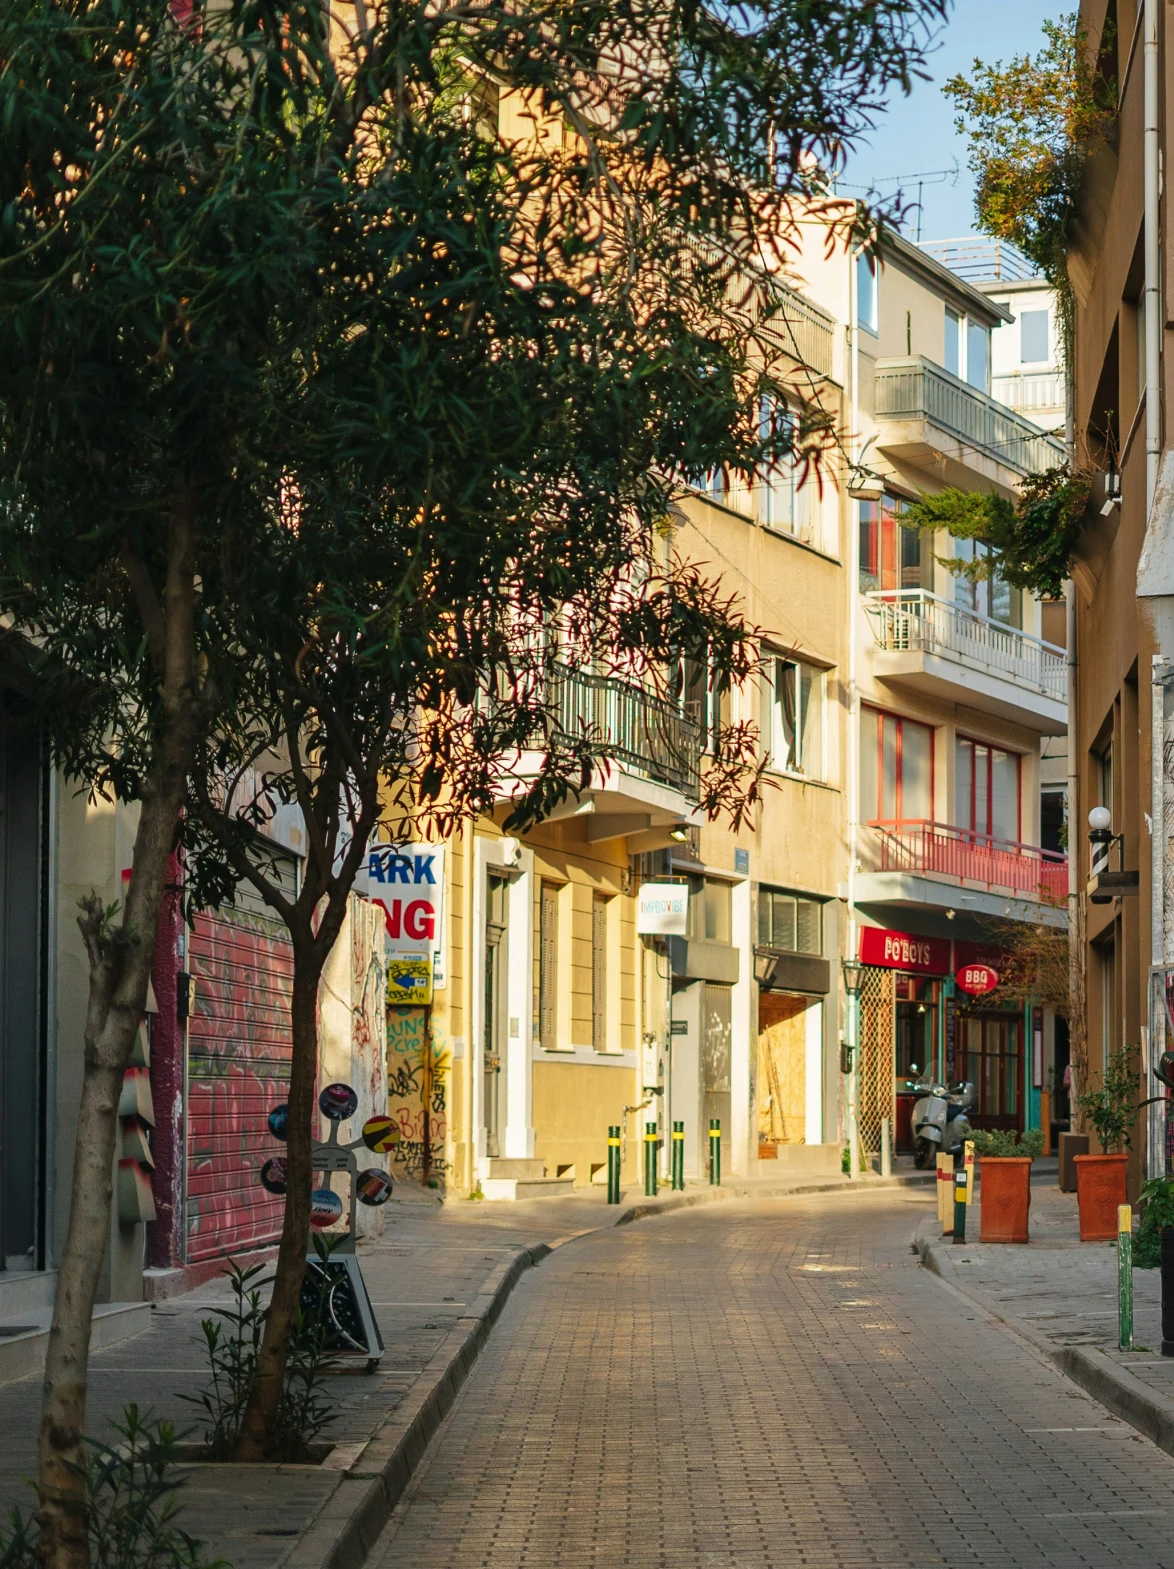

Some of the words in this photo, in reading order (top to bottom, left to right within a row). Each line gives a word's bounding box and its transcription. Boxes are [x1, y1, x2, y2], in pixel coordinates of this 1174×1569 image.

[369, 853, 437, 885] ARK
[641, 900, 683, 914] IMPROVIBE
[367, 898, 435, 940] NG
[965, 970, 988, 983] BBQ
